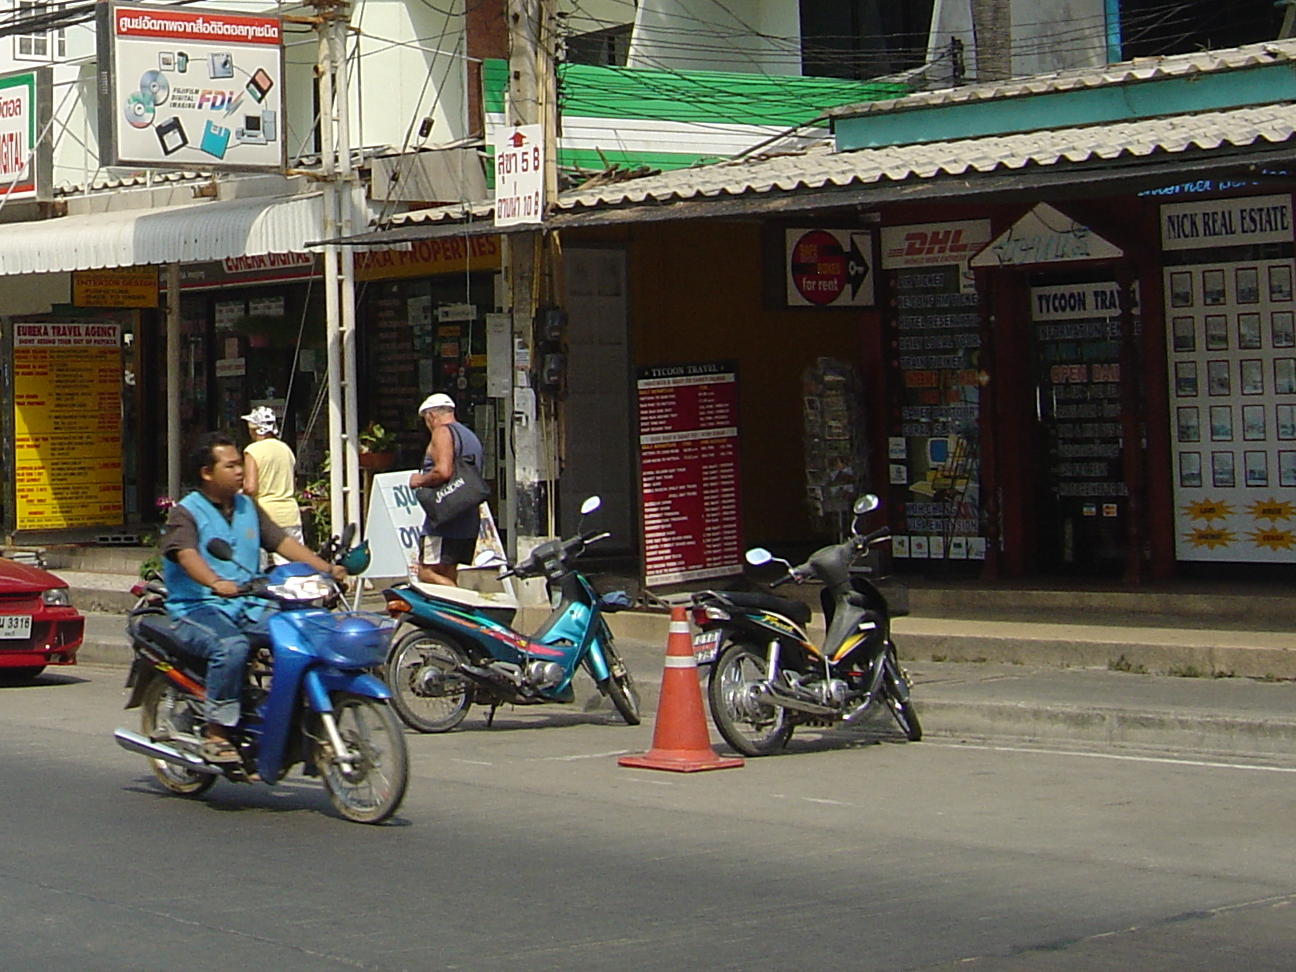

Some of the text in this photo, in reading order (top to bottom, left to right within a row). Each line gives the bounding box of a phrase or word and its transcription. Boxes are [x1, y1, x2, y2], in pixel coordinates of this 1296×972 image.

[521, 151, 529, 172] 5
[1167, 205, 1290, 240] NICK REAL ESTATE
[399, 234, 497, 266] PROPERTIES
[905, 229, 969, 256] DHL
[1037, 291, 1086, 314] TYCOON
[927, 312, 981, 328] RESERVATIO
[17, 325, 117, 338] EUREKA TRAVEL AGENCY
[651, 364, 719, 377] TYCOON TRAVEL
[1051, 364, 1087, 383] OPEN
[7, 617, 30, 629] 3316
